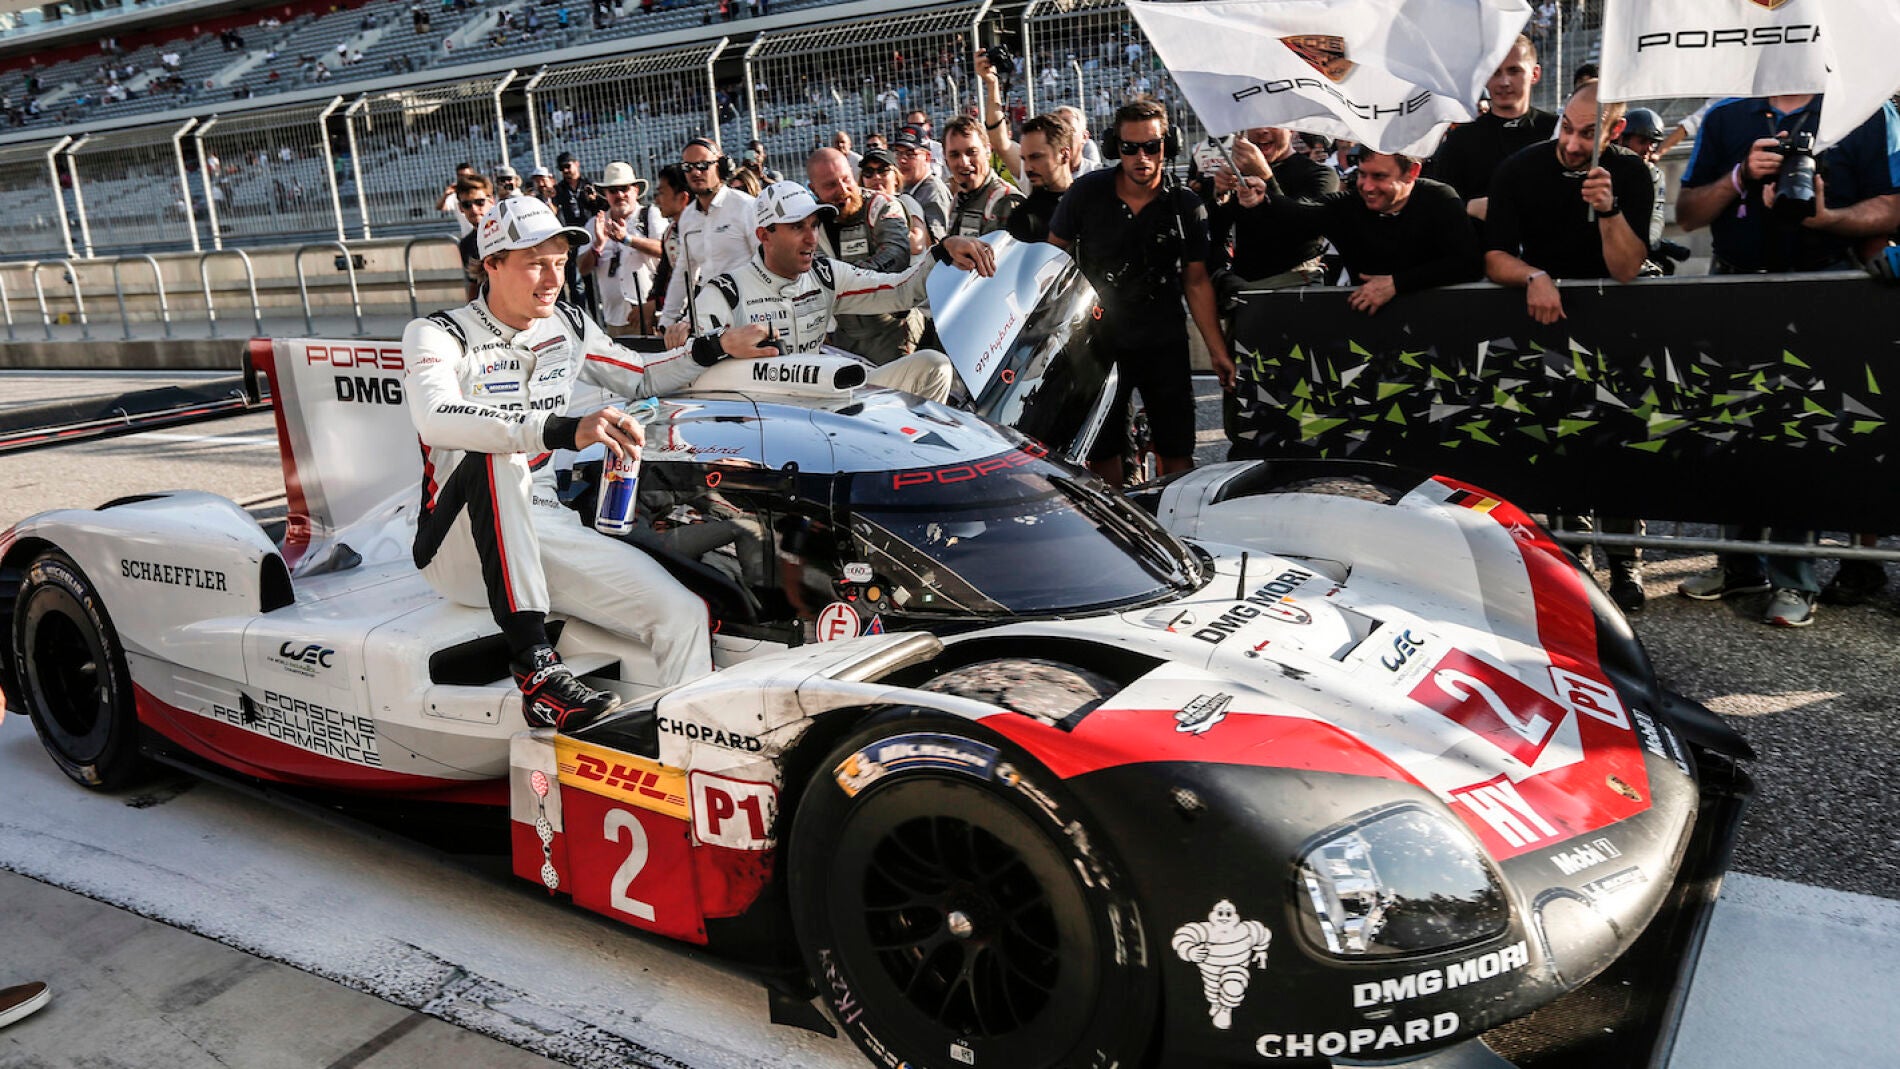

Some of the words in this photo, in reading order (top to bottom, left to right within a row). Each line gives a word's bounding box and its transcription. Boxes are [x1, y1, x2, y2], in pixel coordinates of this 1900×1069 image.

[1232, 78, 1432, 120] PORSCHE
[334, 376, 403, 405] DMG
[752, 362, 802, 383] Mobil
[802, 366, 821, 384] 1
[436, 403, 478, 415] DMG
[121, 559, 228, 592] SCHAEFFLER
[1192, 603, 1262, 645] DMG
[1244, 568, 1313, 608] MORI
[280, 641, 335, 669] WEC
[1381, 628, 1425, 673] WEC
[264, 690, 375, 735] PORSCHE
[1433, 668, 1553, 748] 2
[1562, 675, 1619, 720] P1
[658, 716, 762, 753] CHOPARD
[575, 753, 668, 802] DHL
[704, 786, 769, 841] P1
[1454, 778, 1560, 848] HY
[603, 807, 657, 923] 2
[1353, 968, 1444, 1009] DMG
[1445, 940, 1530, 990] MORI
[1255, 1011, 1460, 1059] CHOPARD
